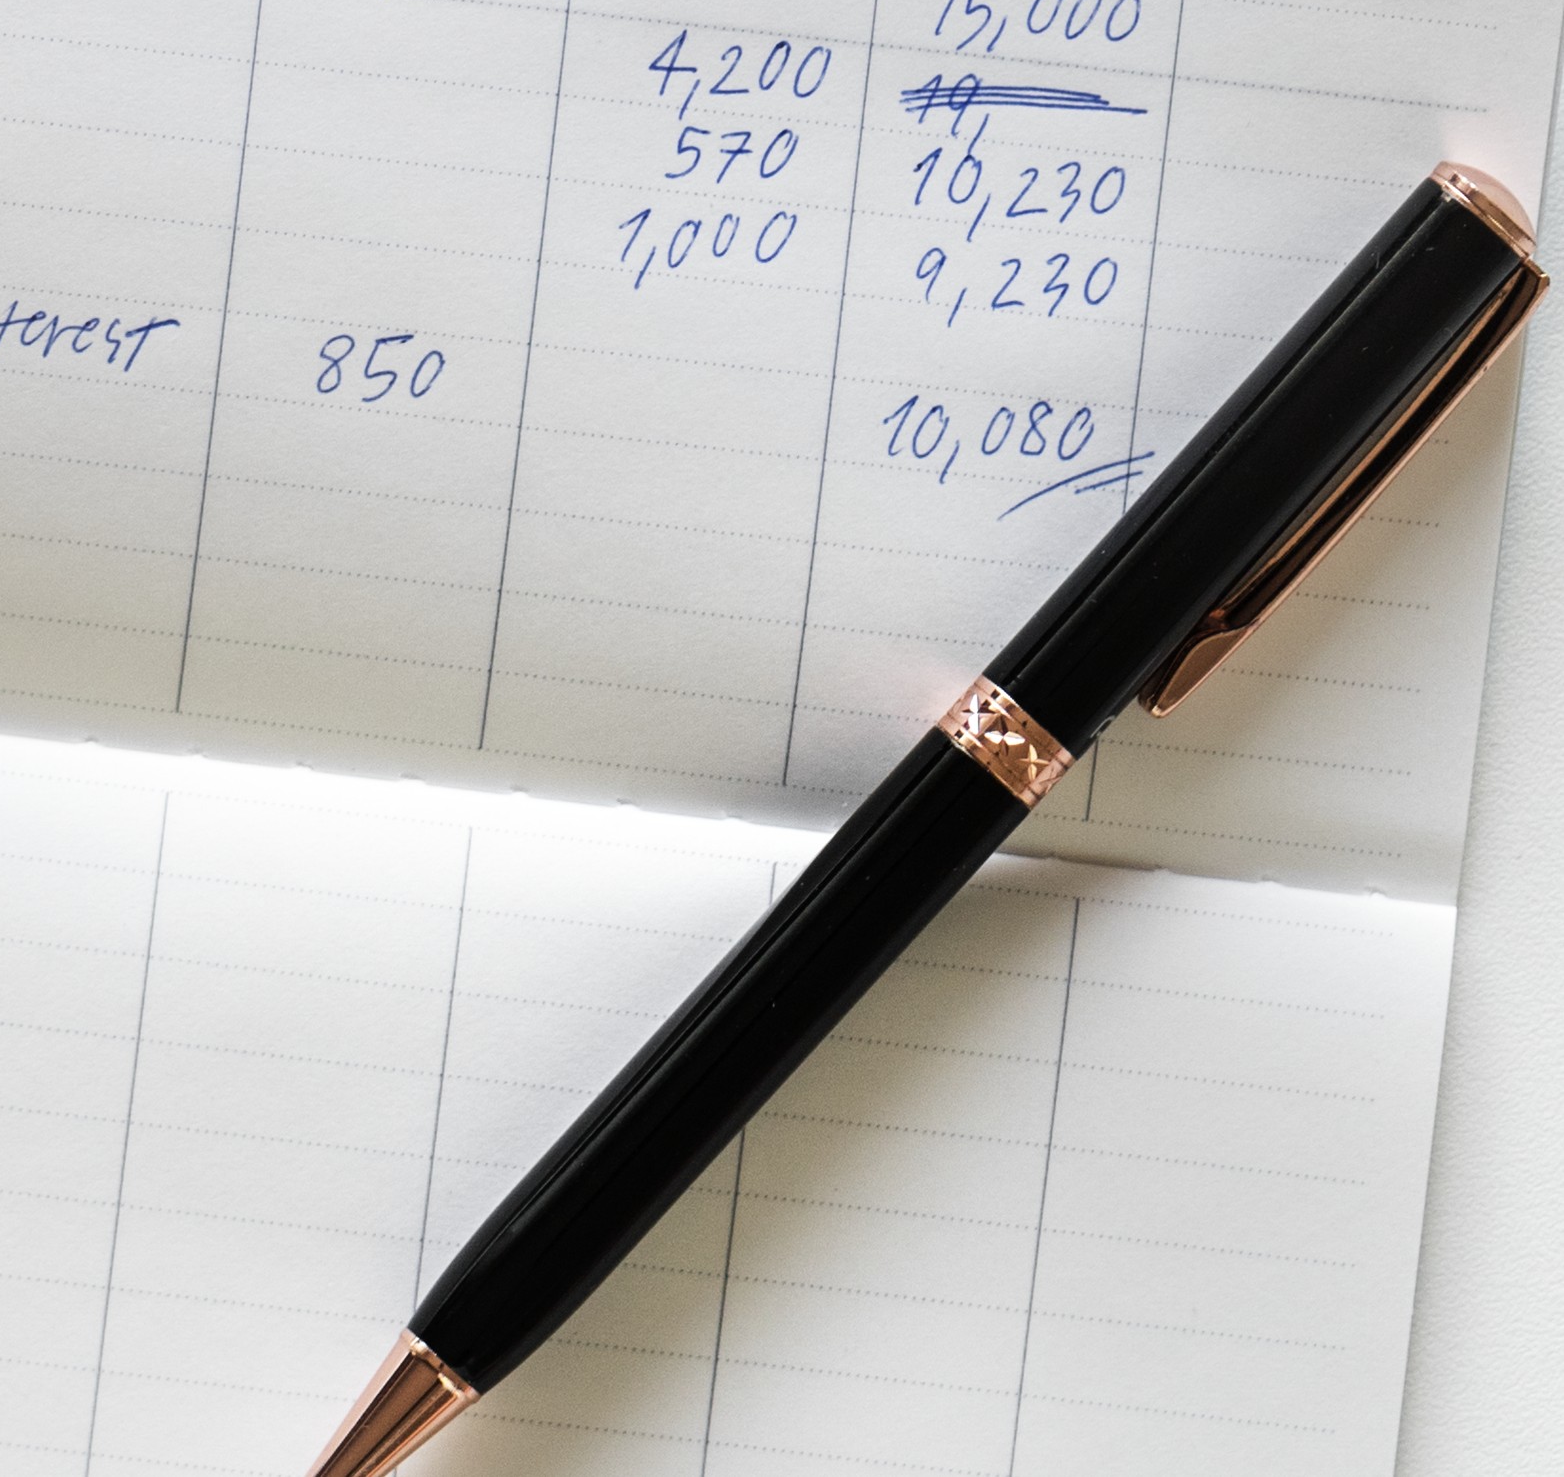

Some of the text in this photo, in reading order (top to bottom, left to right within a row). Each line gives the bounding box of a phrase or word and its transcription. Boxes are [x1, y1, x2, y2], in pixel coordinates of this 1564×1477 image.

[648, 31, 831, 119] 4,200
[663, 126, 800, 183] 570
[913, 147, 1126, 242] 10,230
[618, 208, 798, 290] 1,000
[916, 247, 1118, 326] 9,230
[317, 335, 444, 403] 850
[882, 395, 1095, 484] 10,080
